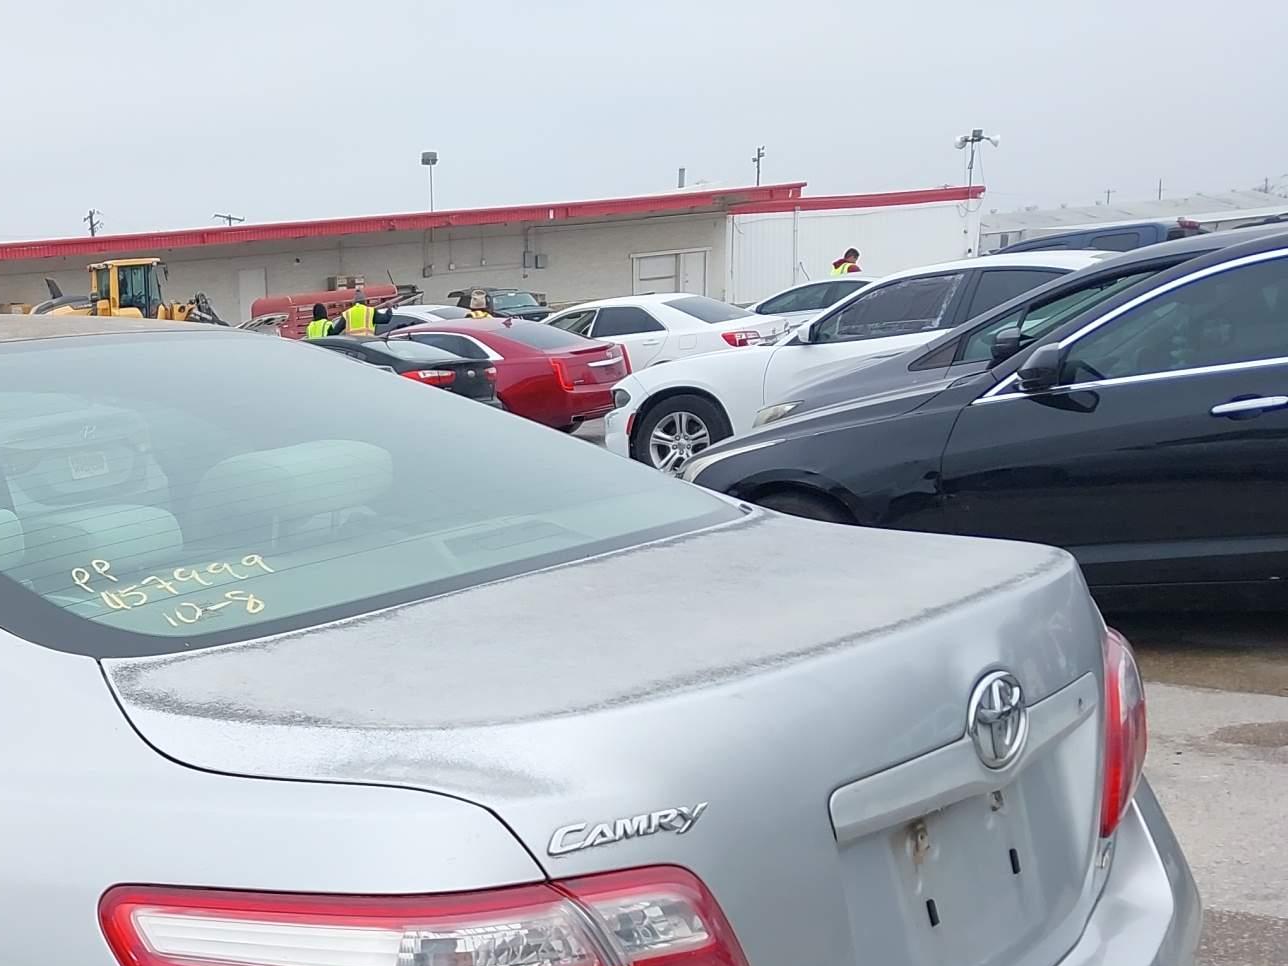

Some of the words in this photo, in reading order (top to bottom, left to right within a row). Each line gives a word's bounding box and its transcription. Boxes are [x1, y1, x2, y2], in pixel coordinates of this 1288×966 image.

[71, 559, 118, 593] PP
[162, 590, 265, 627] 10-8
[546, 801, 708, 856] CAMRY
